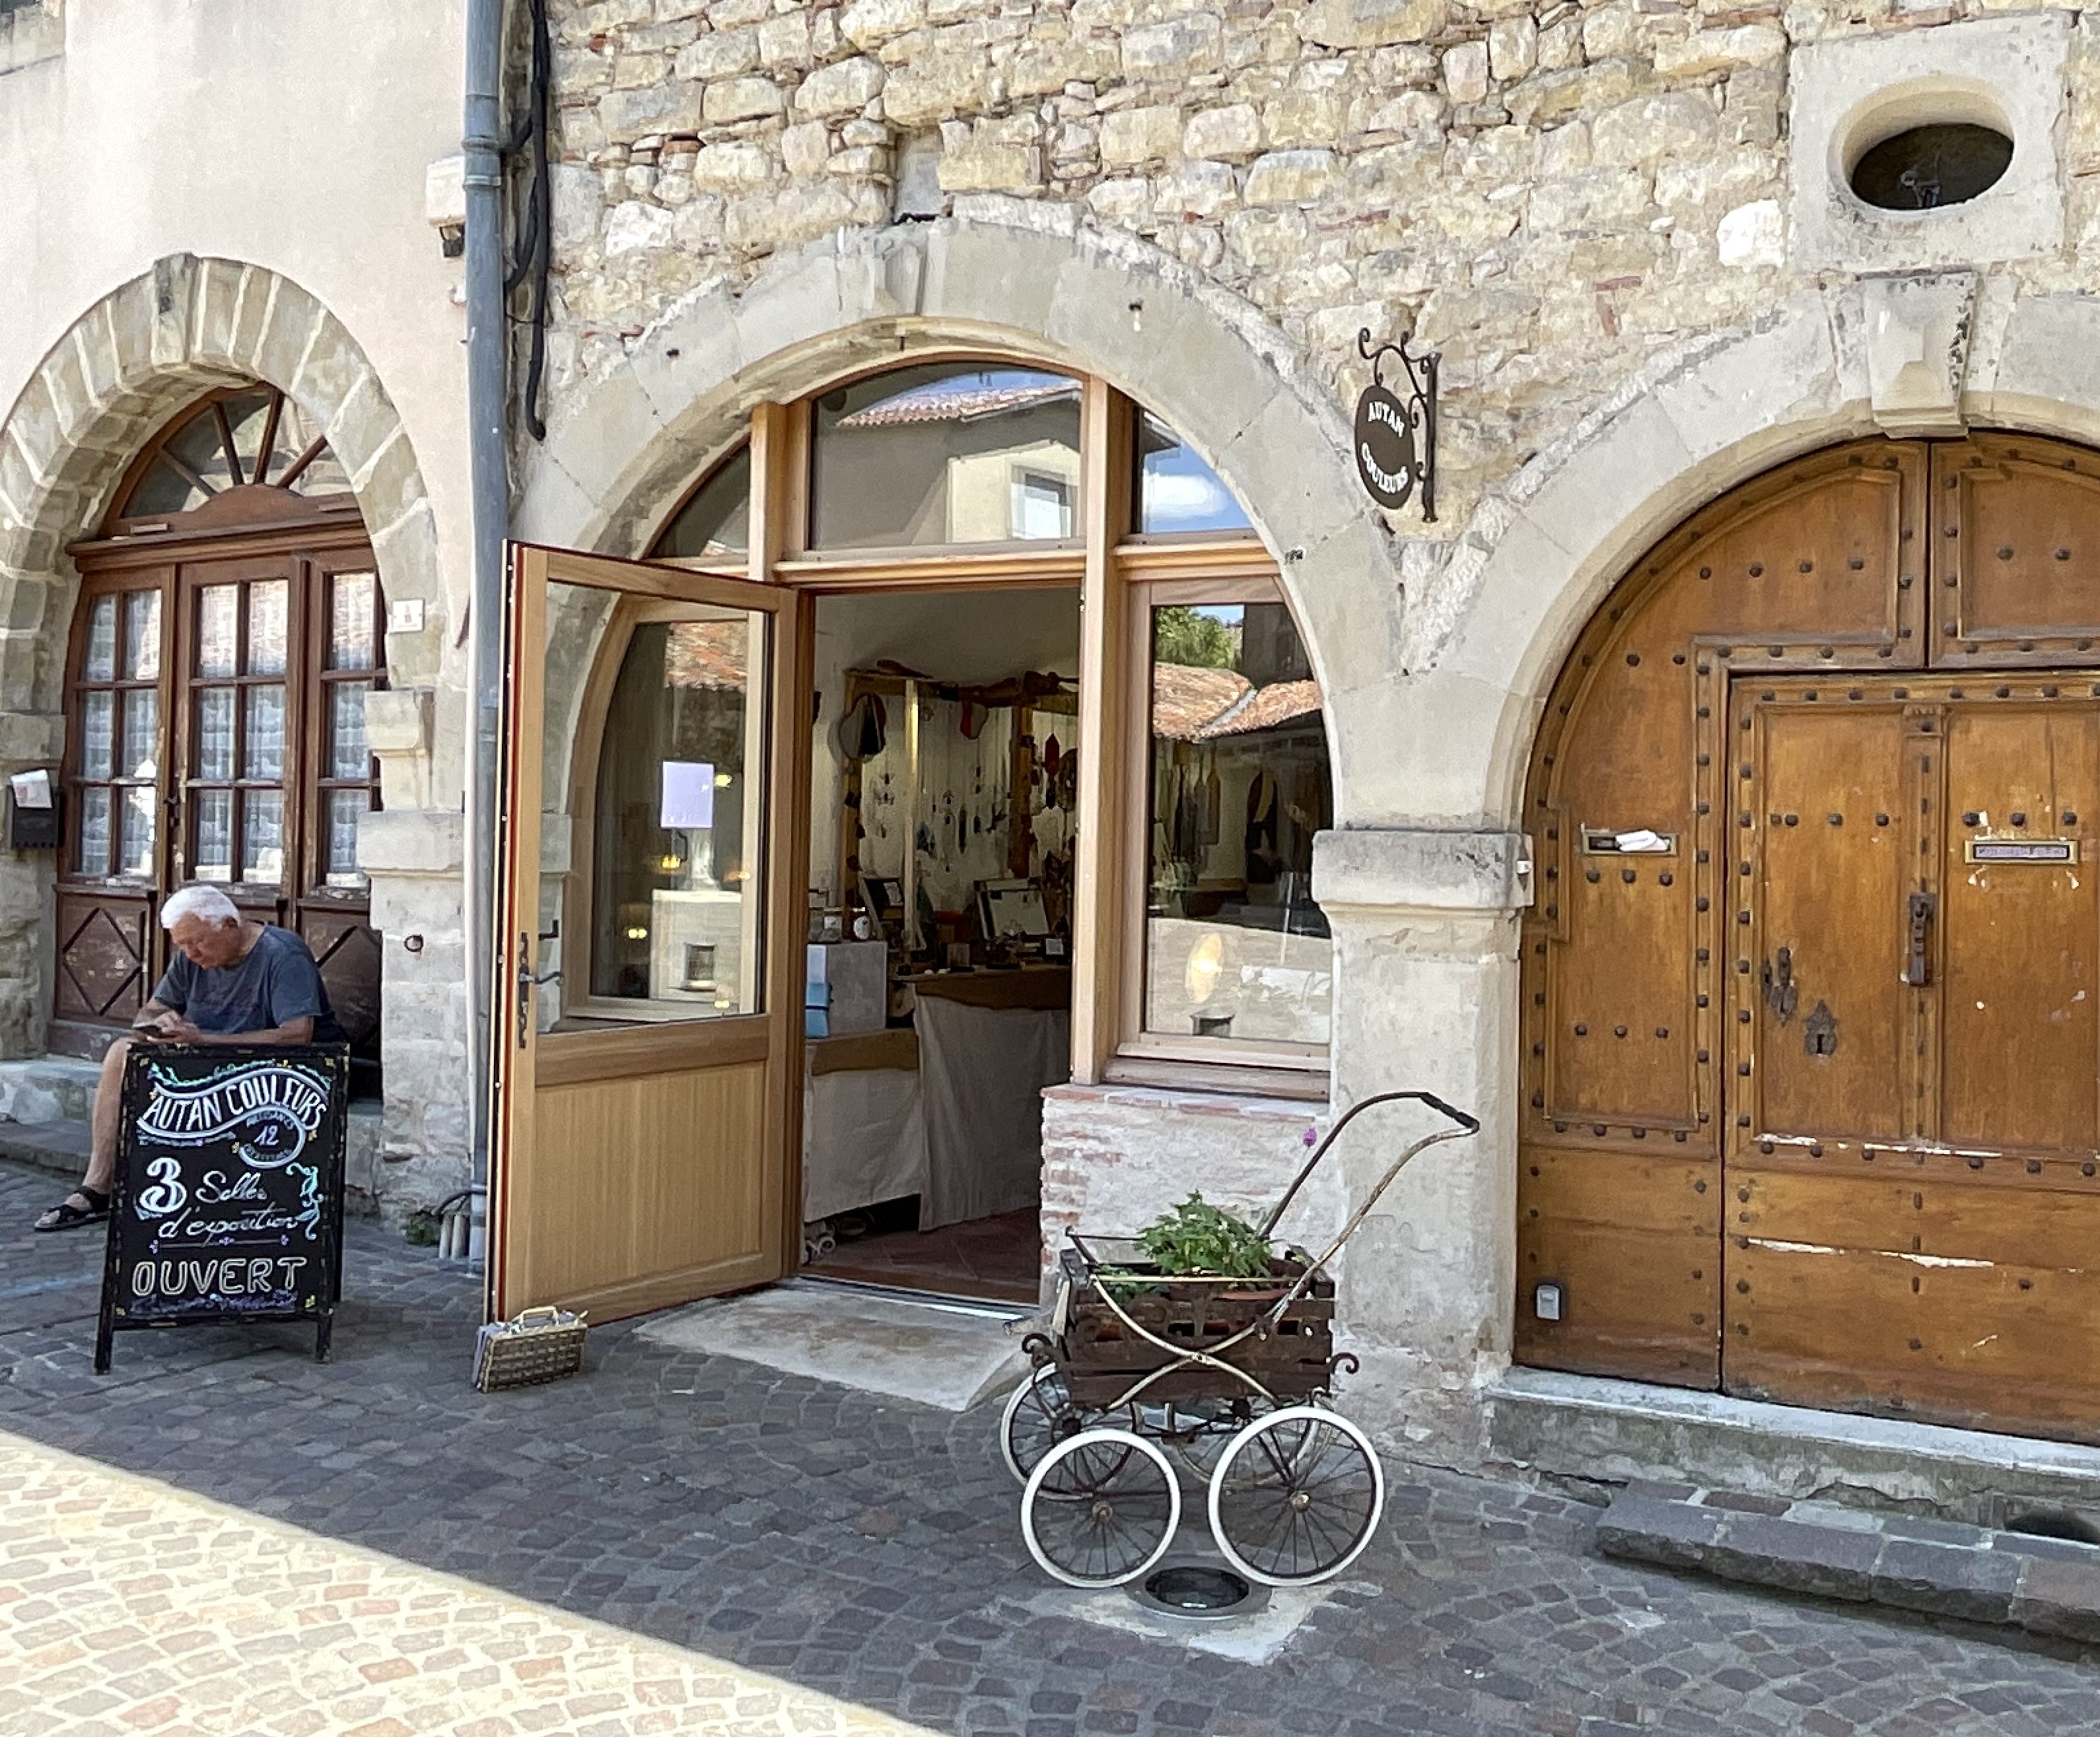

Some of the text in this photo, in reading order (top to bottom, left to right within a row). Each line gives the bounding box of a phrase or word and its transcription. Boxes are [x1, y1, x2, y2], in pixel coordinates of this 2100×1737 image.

[1368, 401, 1405, 438] AUTAN
[141, 1094, 223, 1132] AUTAN
[225, 1073, 328, 1131] COULEURS
[254, 1124, 279, 1146] 12
[139, 1157, 188, 1213] 3
[132, 1256, 308, 1296] OUVERT
